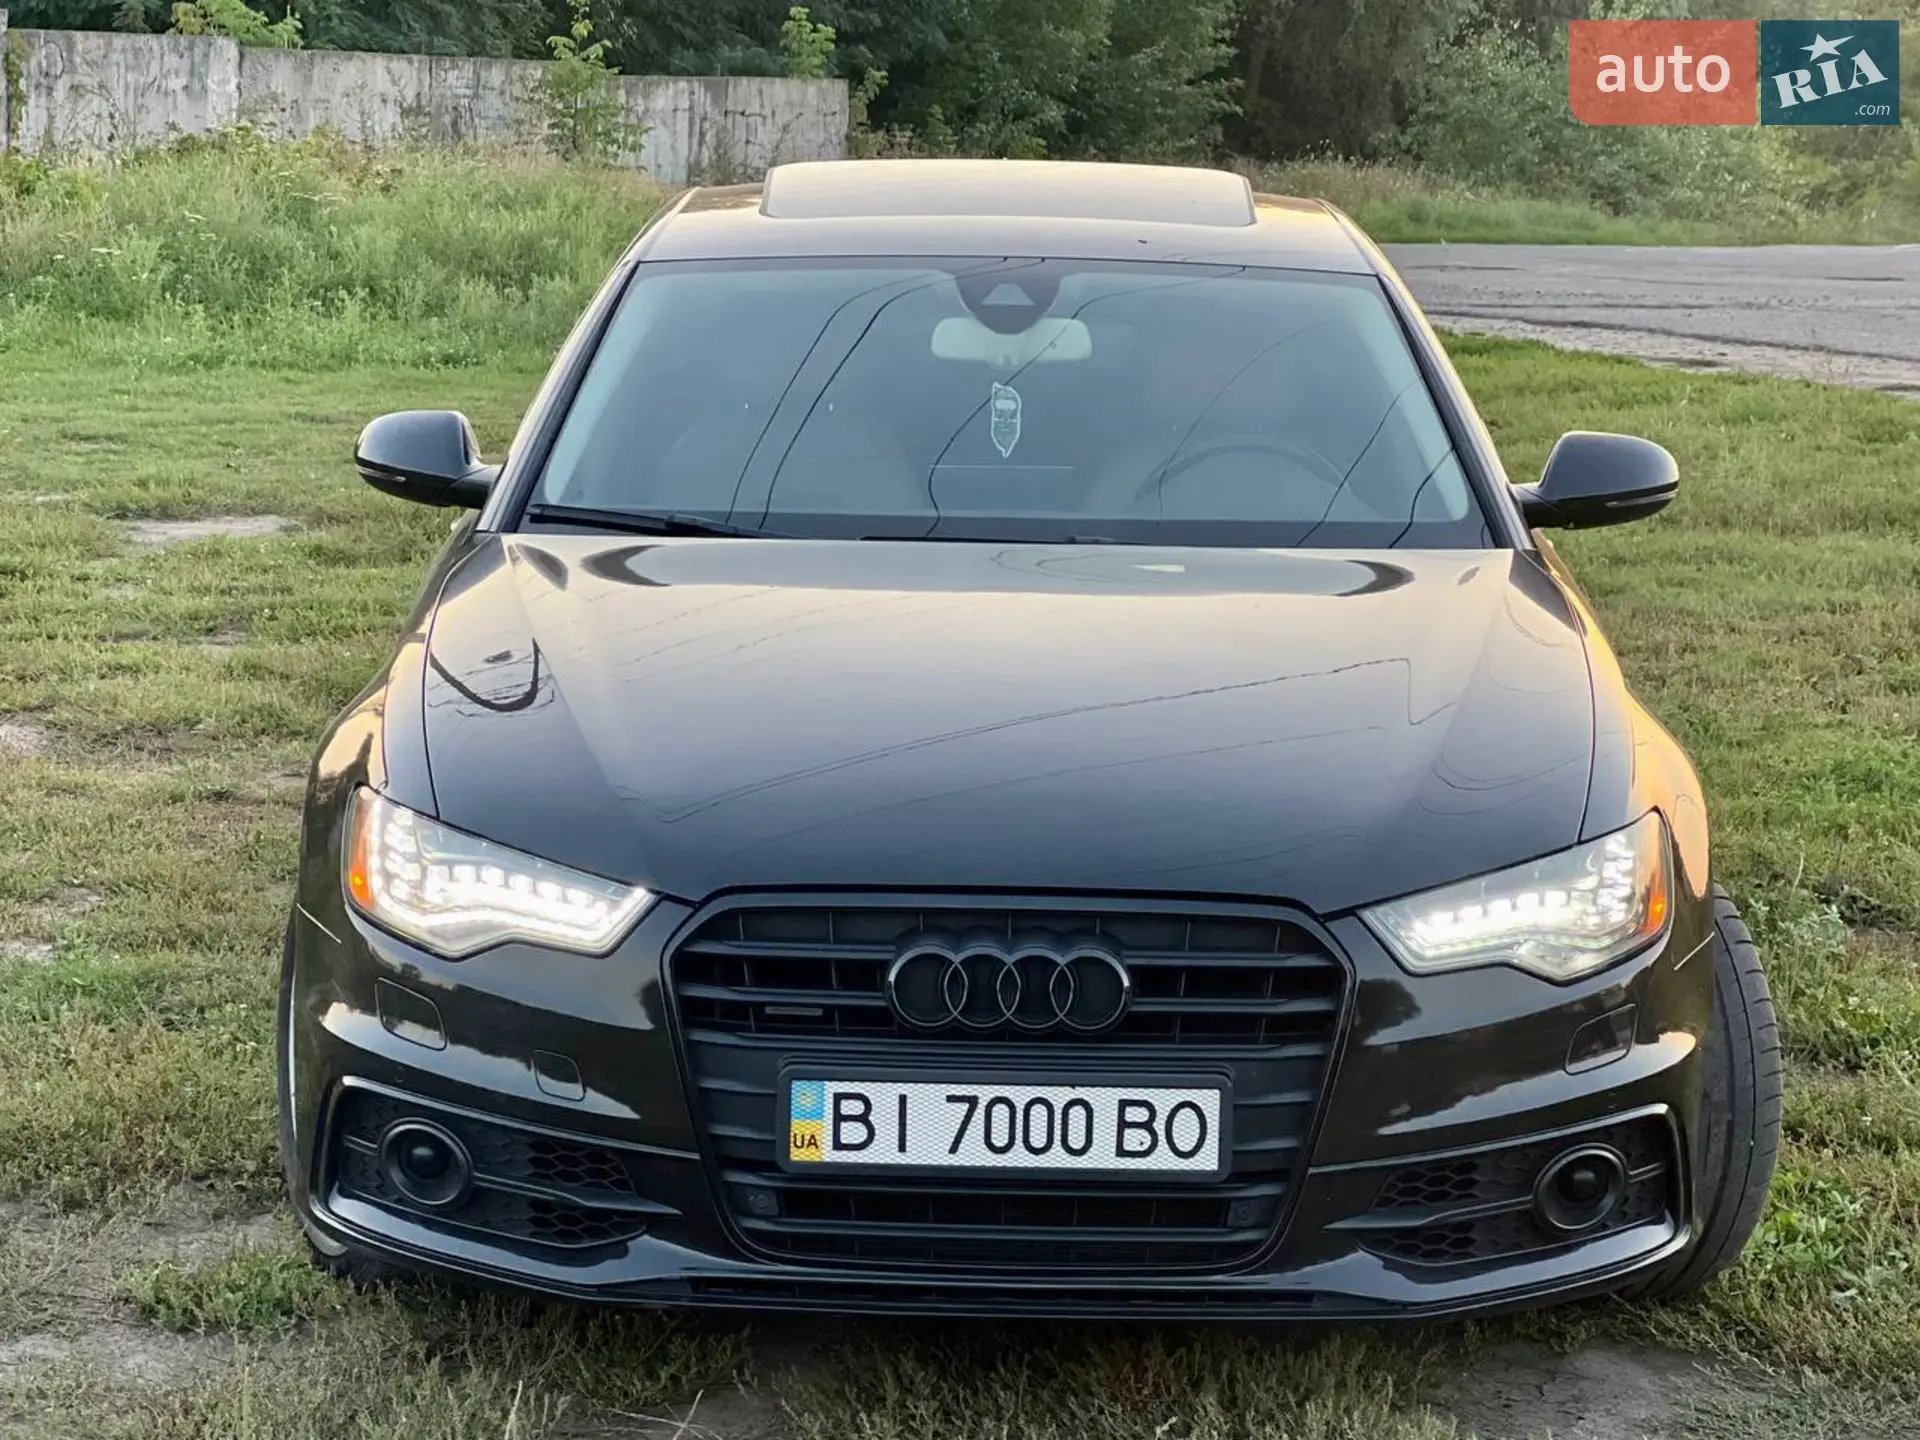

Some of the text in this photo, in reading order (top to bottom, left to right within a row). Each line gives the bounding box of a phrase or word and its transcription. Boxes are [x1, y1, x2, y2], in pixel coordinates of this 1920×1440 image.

[793, 1133, 819, 1150] UA
[945, 1094, 1094, 1156] 7000
[1115, 1099, 1208, 1160] BO
